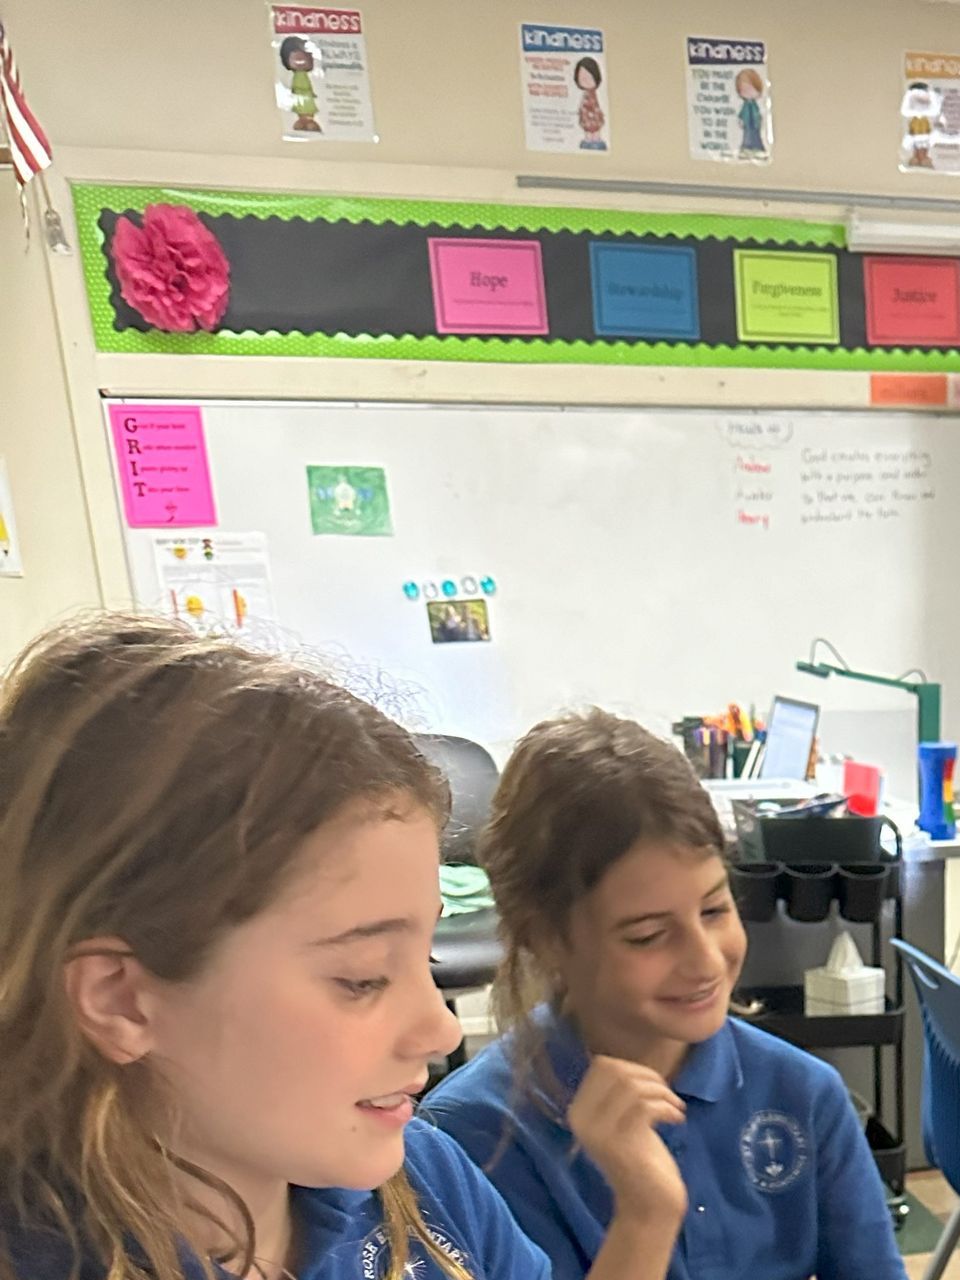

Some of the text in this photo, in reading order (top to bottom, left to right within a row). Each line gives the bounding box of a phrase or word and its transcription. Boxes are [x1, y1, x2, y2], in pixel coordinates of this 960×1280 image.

[276, 10, 360, 31] kindness
[524, 29, 601, 50] kindness
[688, 42, 763, 60] kindness
[470, 271, 508, 291] Hope
[752, 280, 823, 298] Forgiveness
[362, 1241, 379, 1280] ROSE
